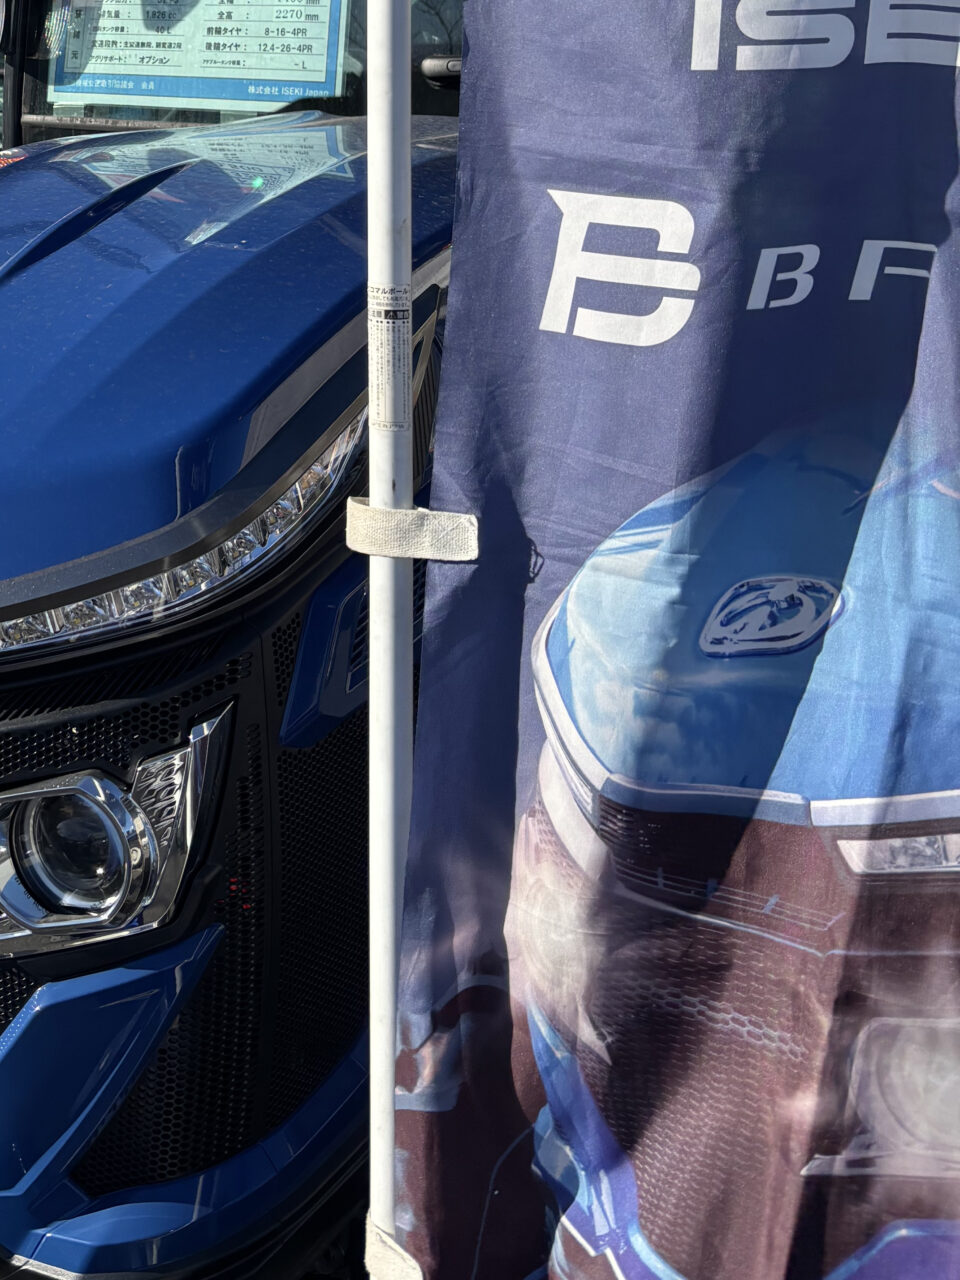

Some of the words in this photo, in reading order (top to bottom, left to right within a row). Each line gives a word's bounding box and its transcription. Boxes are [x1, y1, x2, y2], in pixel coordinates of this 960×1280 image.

[275, 9, 303, 19] 2270
[304, 13, 319, 21] mm
[264, 27, 308, 37] 8-16-4PR
[258, 43, 313, 54] 12.4-26-4PR
[281, 86, 303, 95] ISEKI
